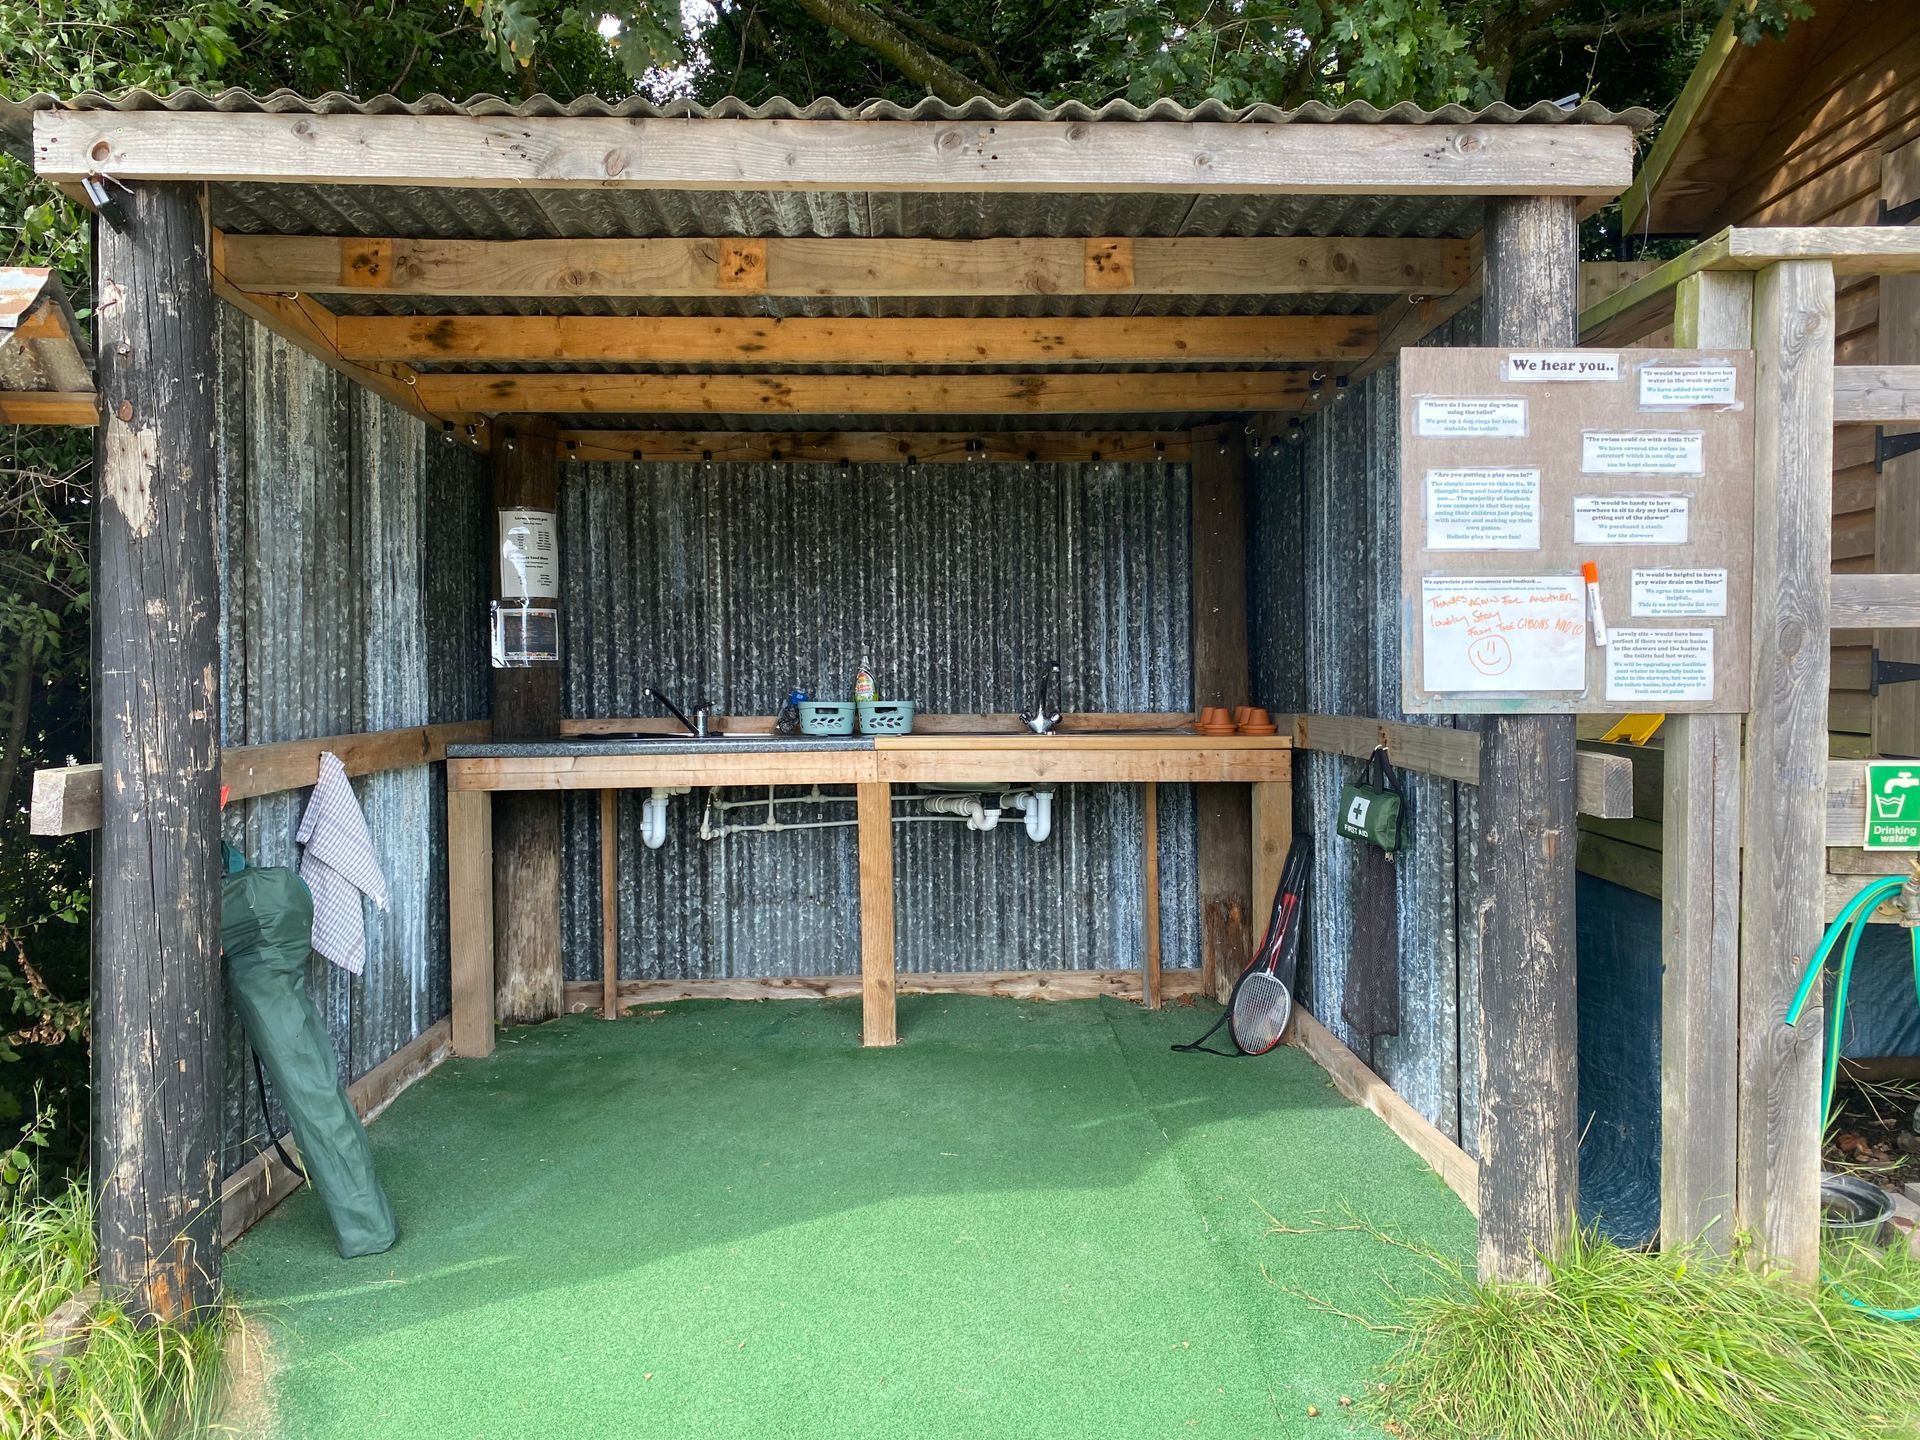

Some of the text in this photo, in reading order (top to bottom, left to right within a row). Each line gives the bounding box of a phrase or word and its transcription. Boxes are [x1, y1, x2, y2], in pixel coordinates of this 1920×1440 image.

[1513, 359, 1537, 371] We
[1541, 359, 1576, 371] hear
[1344, 824, 1368, 837] FIRST AID
[1874, 826, 1917, 836] Drinking
